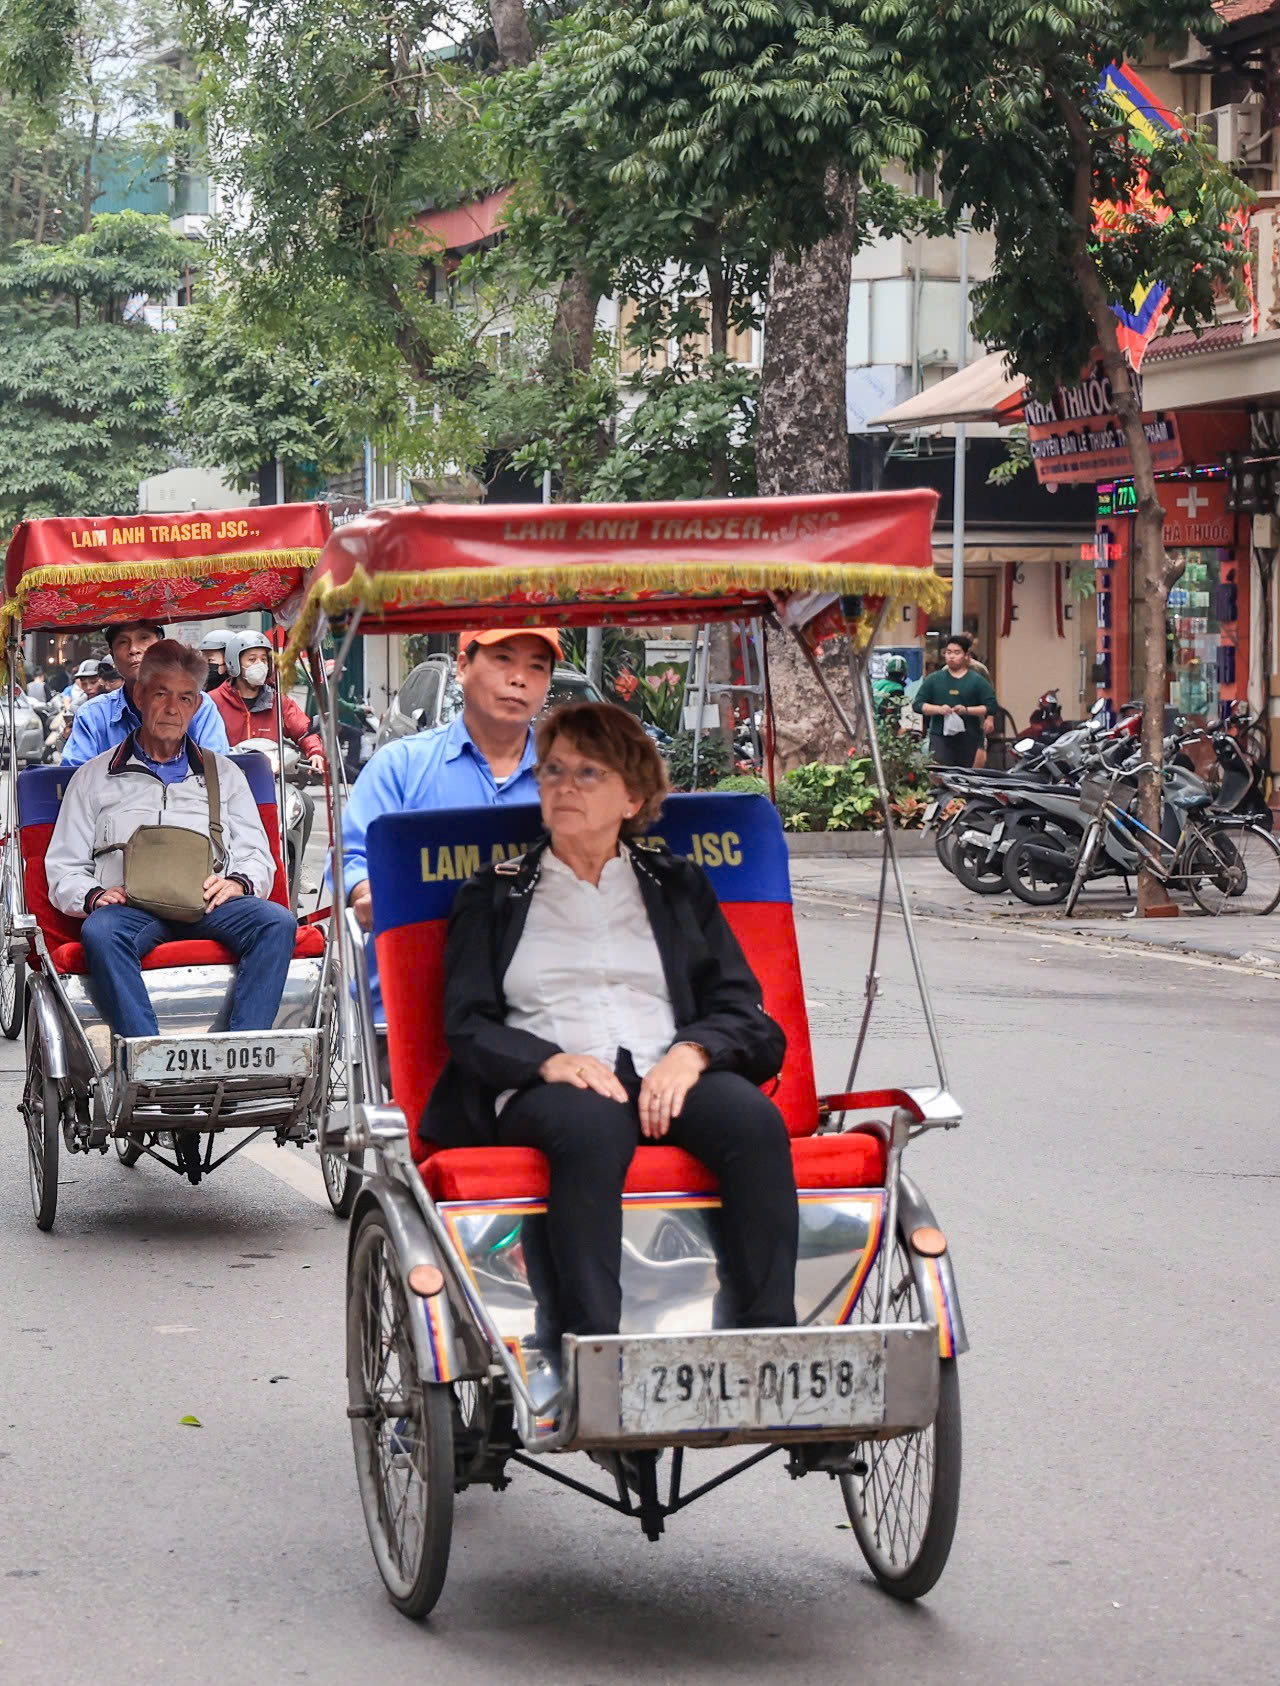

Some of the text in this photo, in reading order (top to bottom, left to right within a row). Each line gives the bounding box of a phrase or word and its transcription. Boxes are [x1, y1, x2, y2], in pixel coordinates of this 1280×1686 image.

[71, 529, 108, 548] LAM
[112, 526, 146, 545] ANH
[149, 522, 212, 543] TRASER
[503, 517, 567, 541] LAM
[576, 518, 640, 541] ANH
[421, 845, 480, 882] LAM
[686, 831, 742, 867] JSC
